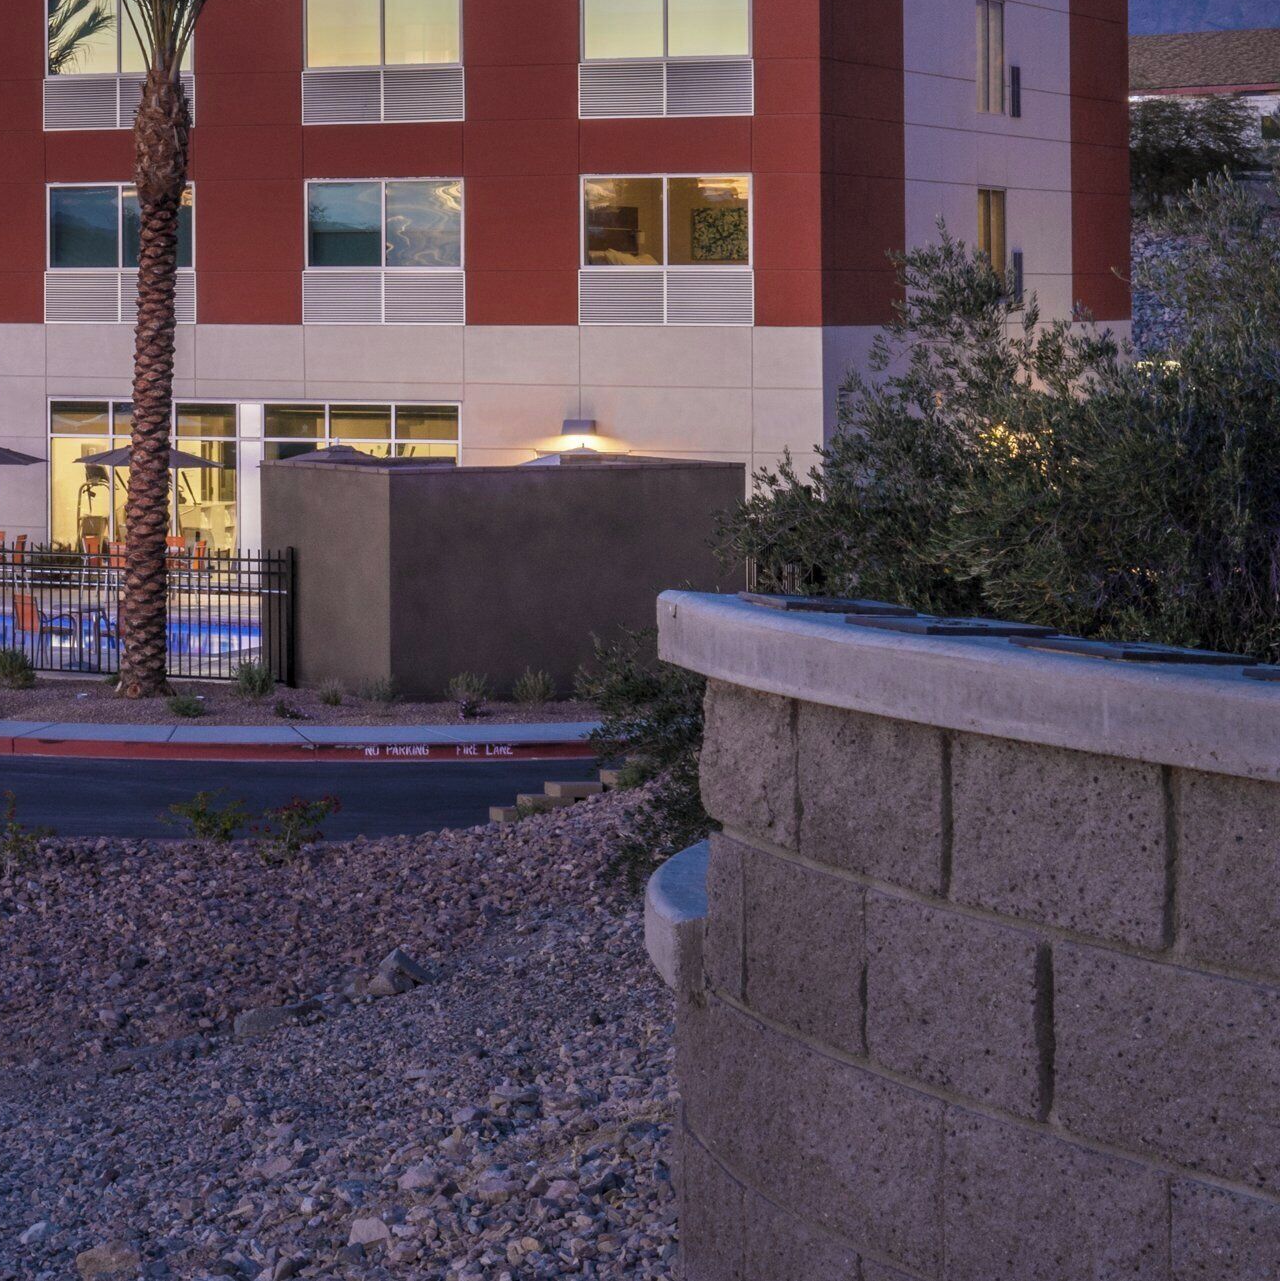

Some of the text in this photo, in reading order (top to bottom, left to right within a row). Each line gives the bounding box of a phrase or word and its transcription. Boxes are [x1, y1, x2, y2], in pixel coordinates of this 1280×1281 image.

[365, 744, 512, 755] NO PARKING FIRE LANE
